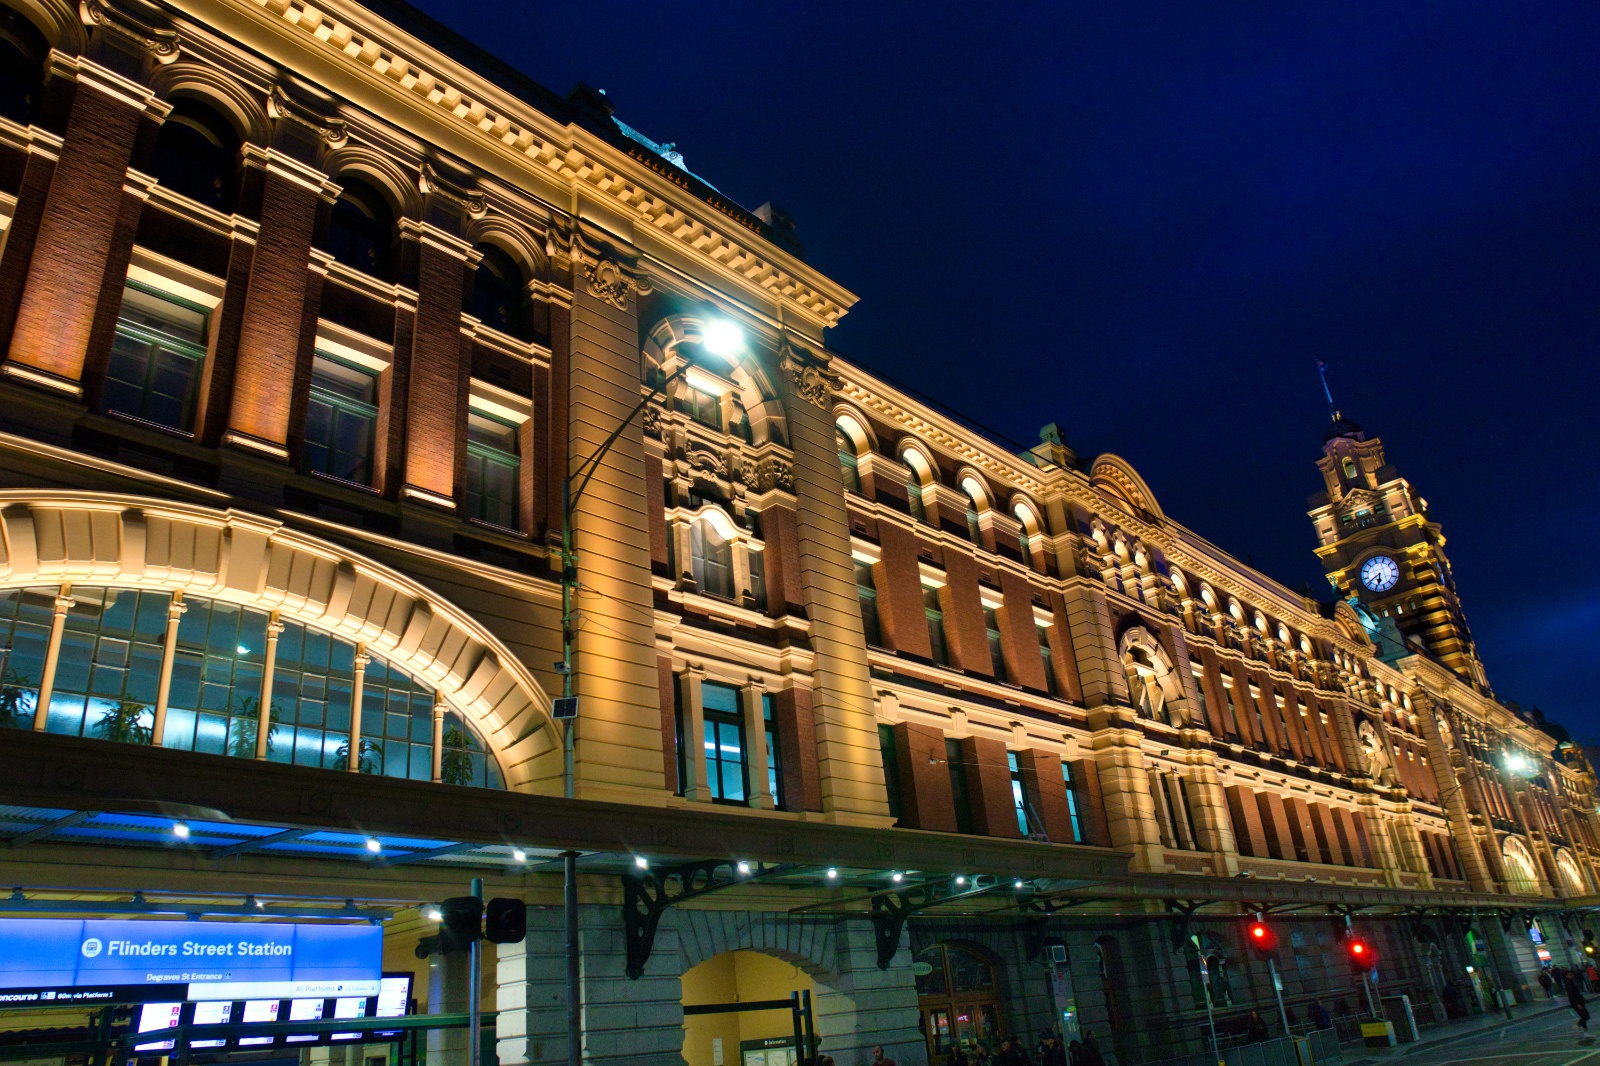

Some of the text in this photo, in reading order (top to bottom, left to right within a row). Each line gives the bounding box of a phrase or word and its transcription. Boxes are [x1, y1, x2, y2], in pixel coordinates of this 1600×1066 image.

[107, 940, 292, 956] Flinders Street Station
[146, 972, 223, 982] Degraves St Entrance
[82, 991, 109, 999] Platform
